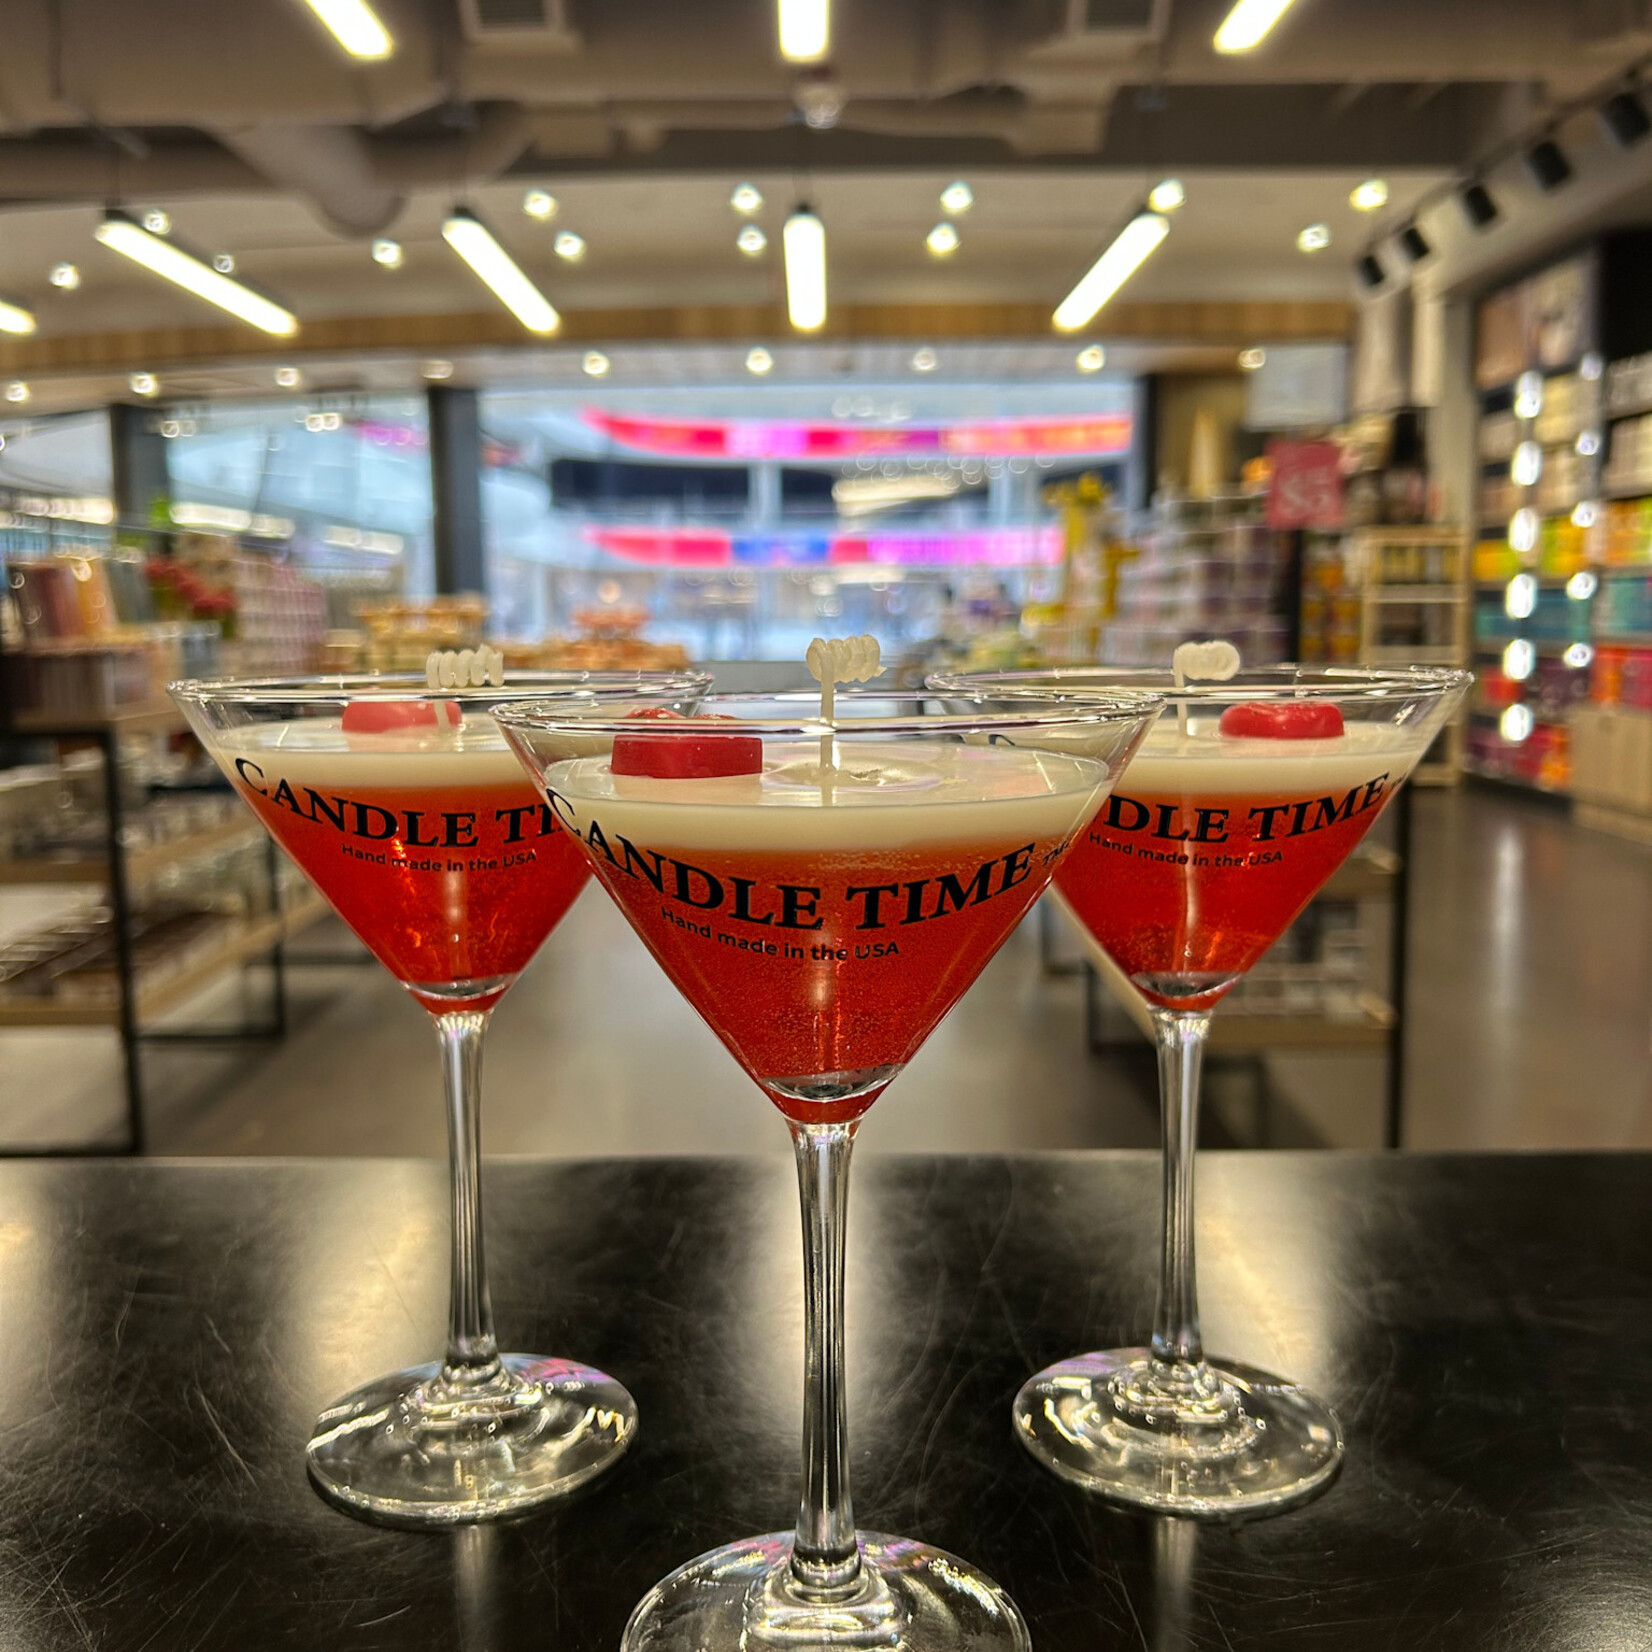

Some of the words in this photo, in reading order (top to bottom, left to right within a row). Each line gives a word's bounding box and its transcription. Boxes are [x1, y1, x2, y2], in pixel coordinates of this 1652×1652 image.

[235, 757, 479, 848] CANDLE
[495, 803, 564, 844] TI
[1093, 794, 1230, 843] DLE
[1248, 770, 1389, 842] TIME
[341, 843, 386, 865] Hand
[391, 857, 442, 872] made
[446, 859, 464, 872] in
[468, 857, 498, 871] the
[503, 850, 537, 868] USA
[546, 788, 824, 930] CANDLE
[845, 841, 1036, 930] TIME
[1089, 832, 1134, 855] Hand
[1138, 848, 1189, 865] made
[1193, 853, 1209, 867] in
[1214, 854, 1244, 867] the
[1249, 851, 1284, 867] USA
[661, 906, 712, 938] Hand
[717, 932, 779, 956] made
[784, 942, 804, 959] in
[810, 943, 849, 961] the
[854, 941, 900, 960] USA
